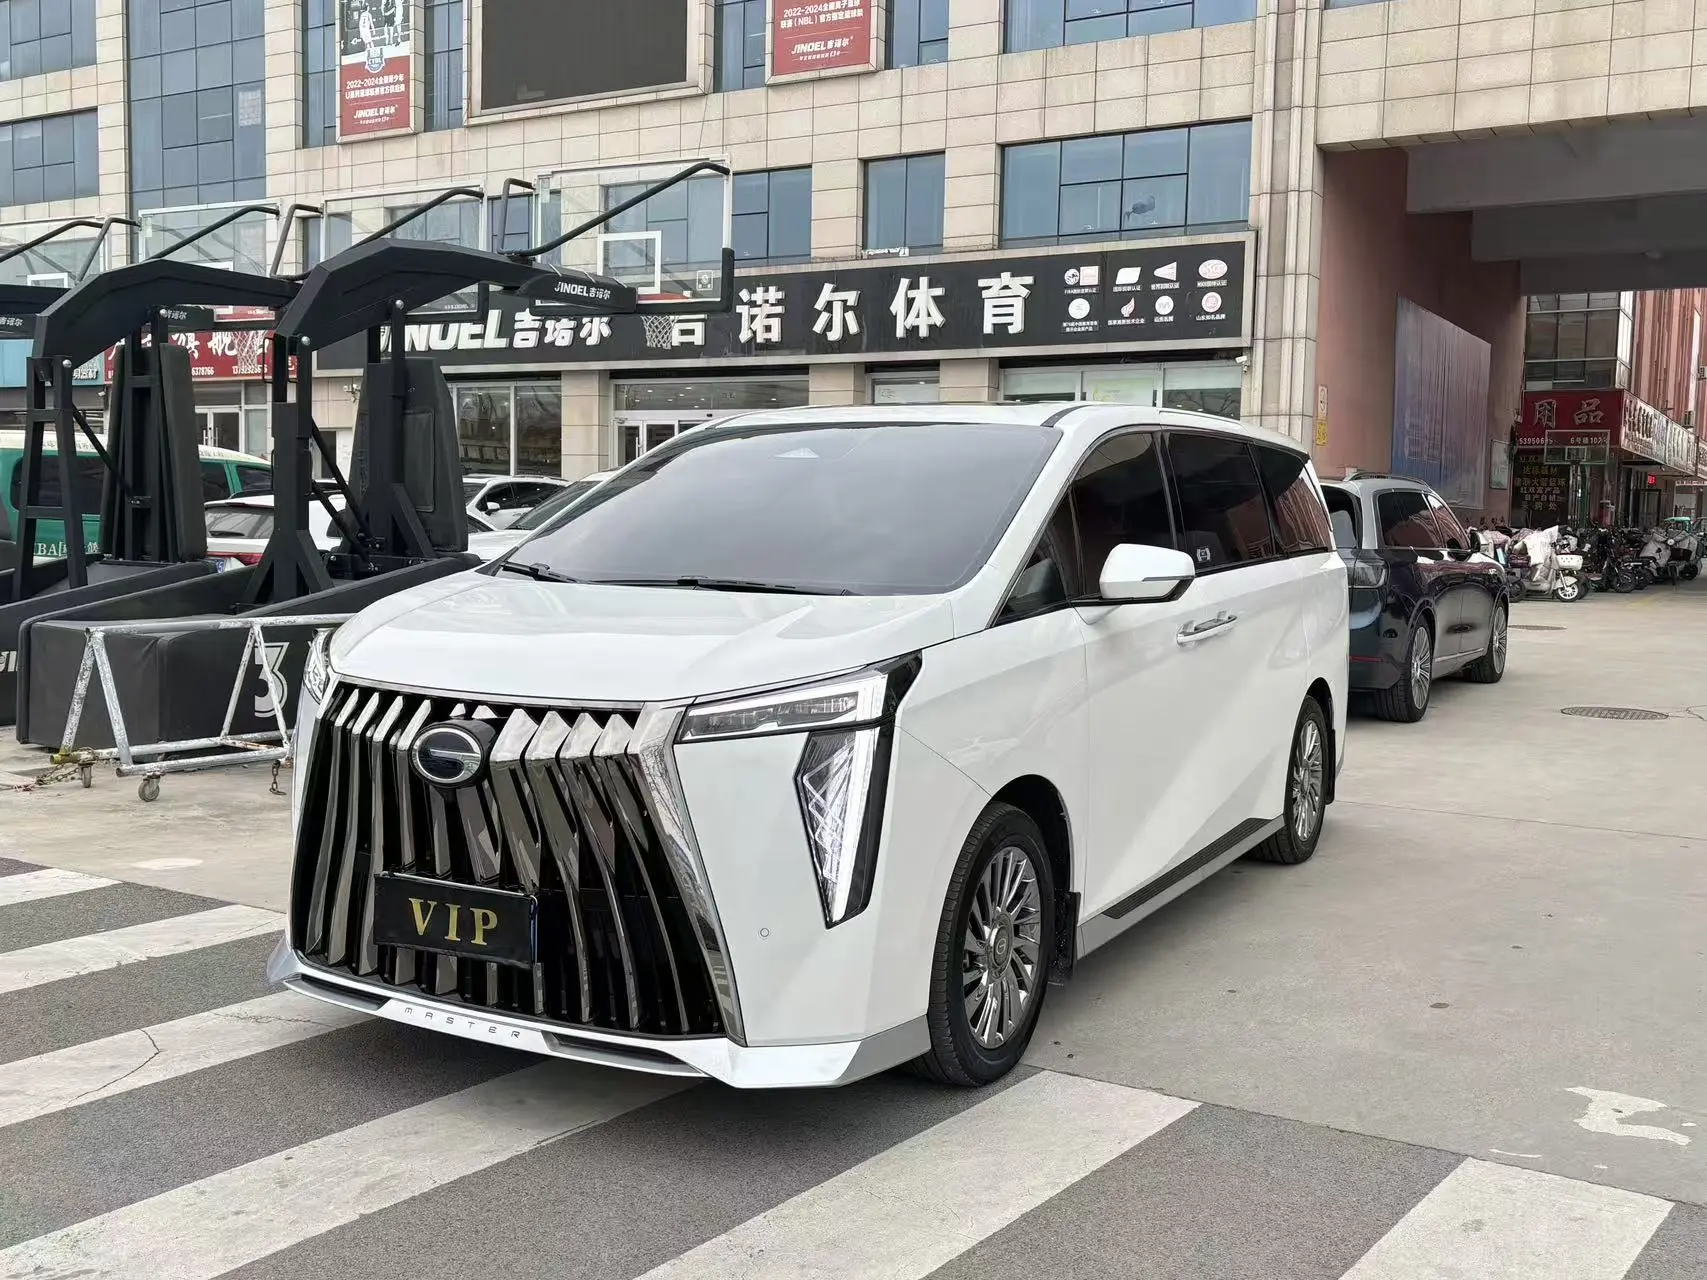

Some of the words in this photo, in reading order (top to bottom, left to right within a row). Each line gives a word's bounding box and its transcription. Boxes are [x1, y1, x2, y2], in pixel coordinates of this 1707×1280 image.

[1533, 398, 1604, 429] 用品
[408, 897, 499, 947] VIP
[403, 1006, 521, 1040] MASTER
